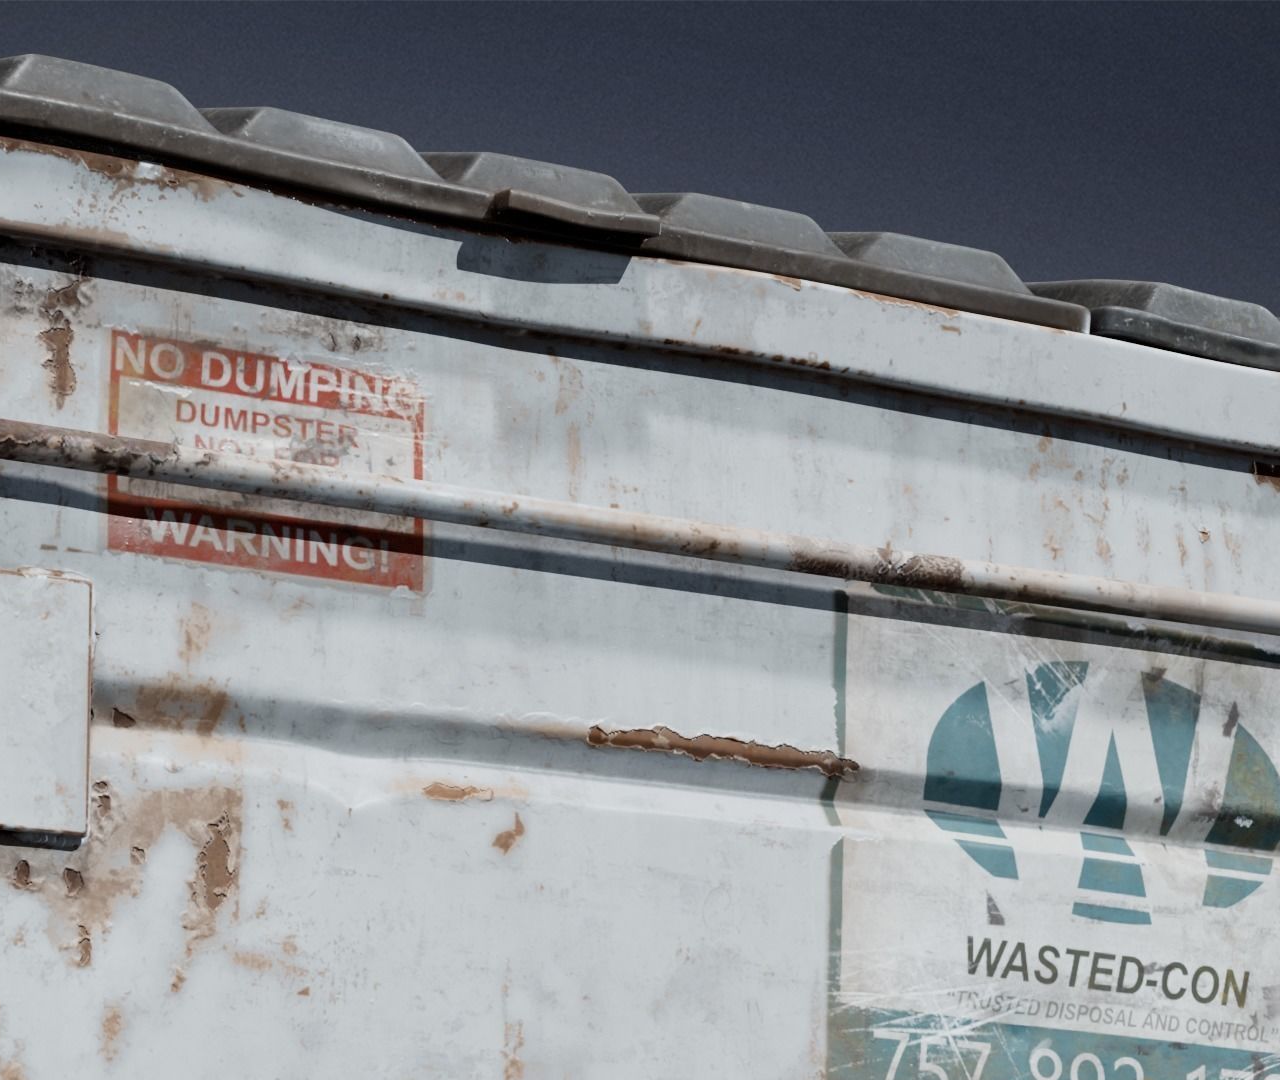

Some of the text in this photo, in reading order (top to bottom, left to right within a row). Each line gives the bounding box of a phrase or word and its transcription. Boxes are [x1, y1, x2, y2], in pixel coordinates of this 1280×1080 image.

[115, 335, 421, 413] NO DUMPING
[176, 400, 360, 448] DUMPSTER
[144, 506, 390, 574] WARNING!
[966, 935, 1250, 1009] WASTED-CON
[1045, 1000, 1138, 1028] DISPOSAL
[1142, 1010, 1181, 1033] AND
